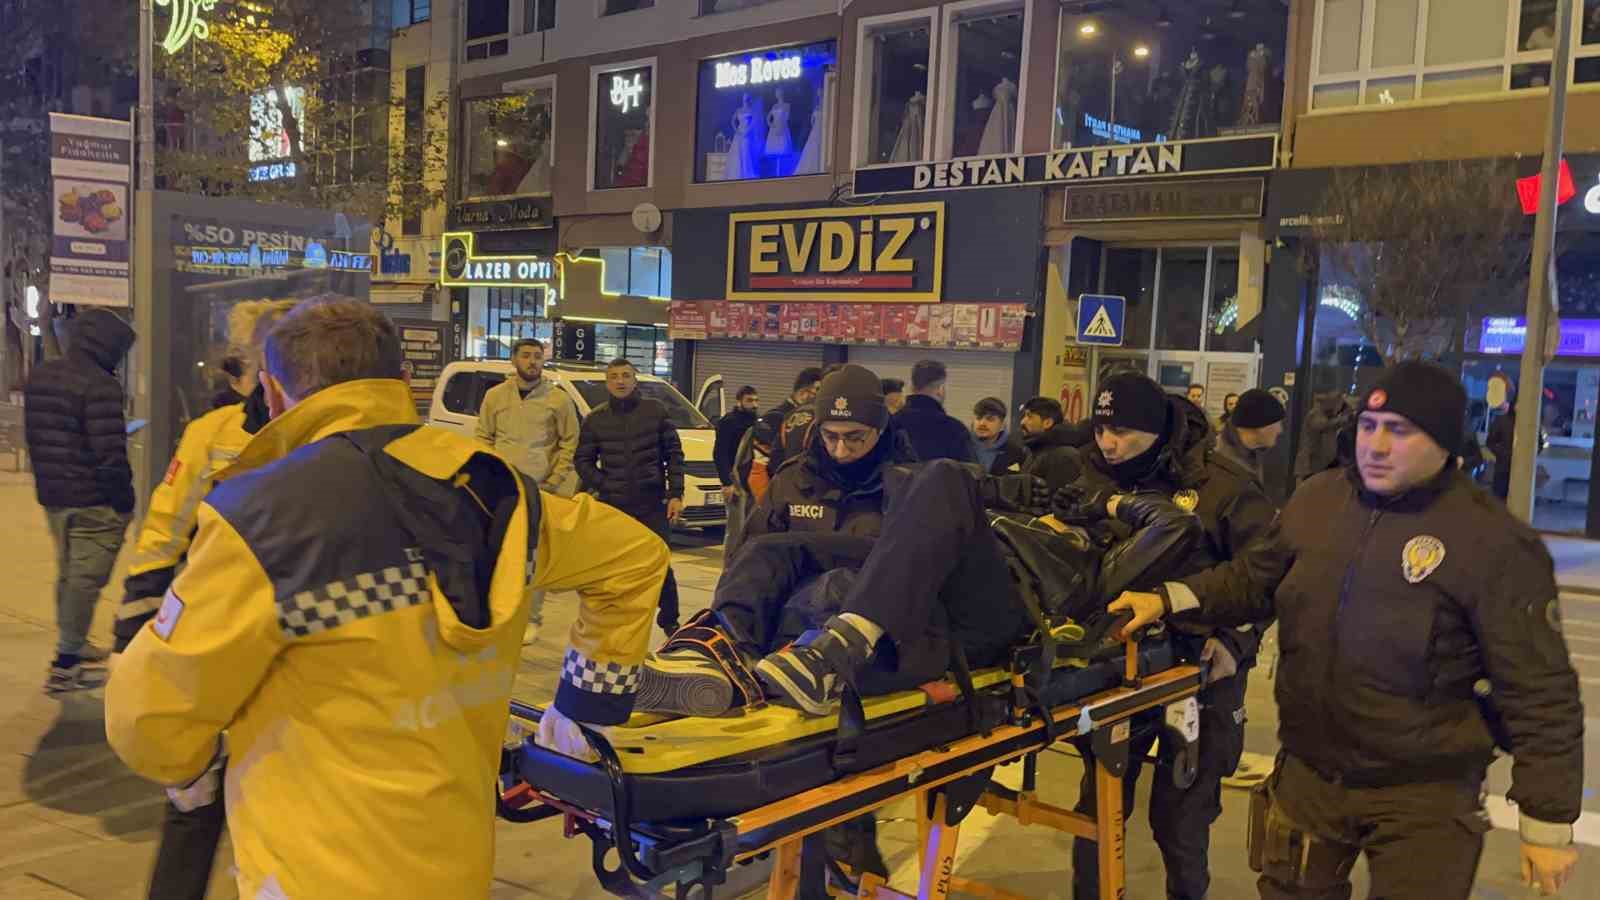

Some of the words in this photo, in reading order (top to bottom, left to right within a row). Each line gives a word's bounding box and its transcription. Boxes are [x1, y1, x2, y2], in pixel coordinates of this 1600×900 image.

[912, 156, 1025, 189] DESTAN
[1044, 143, 1182, 180] KAFTAN
[465, 261, 511, 279] LAZER
